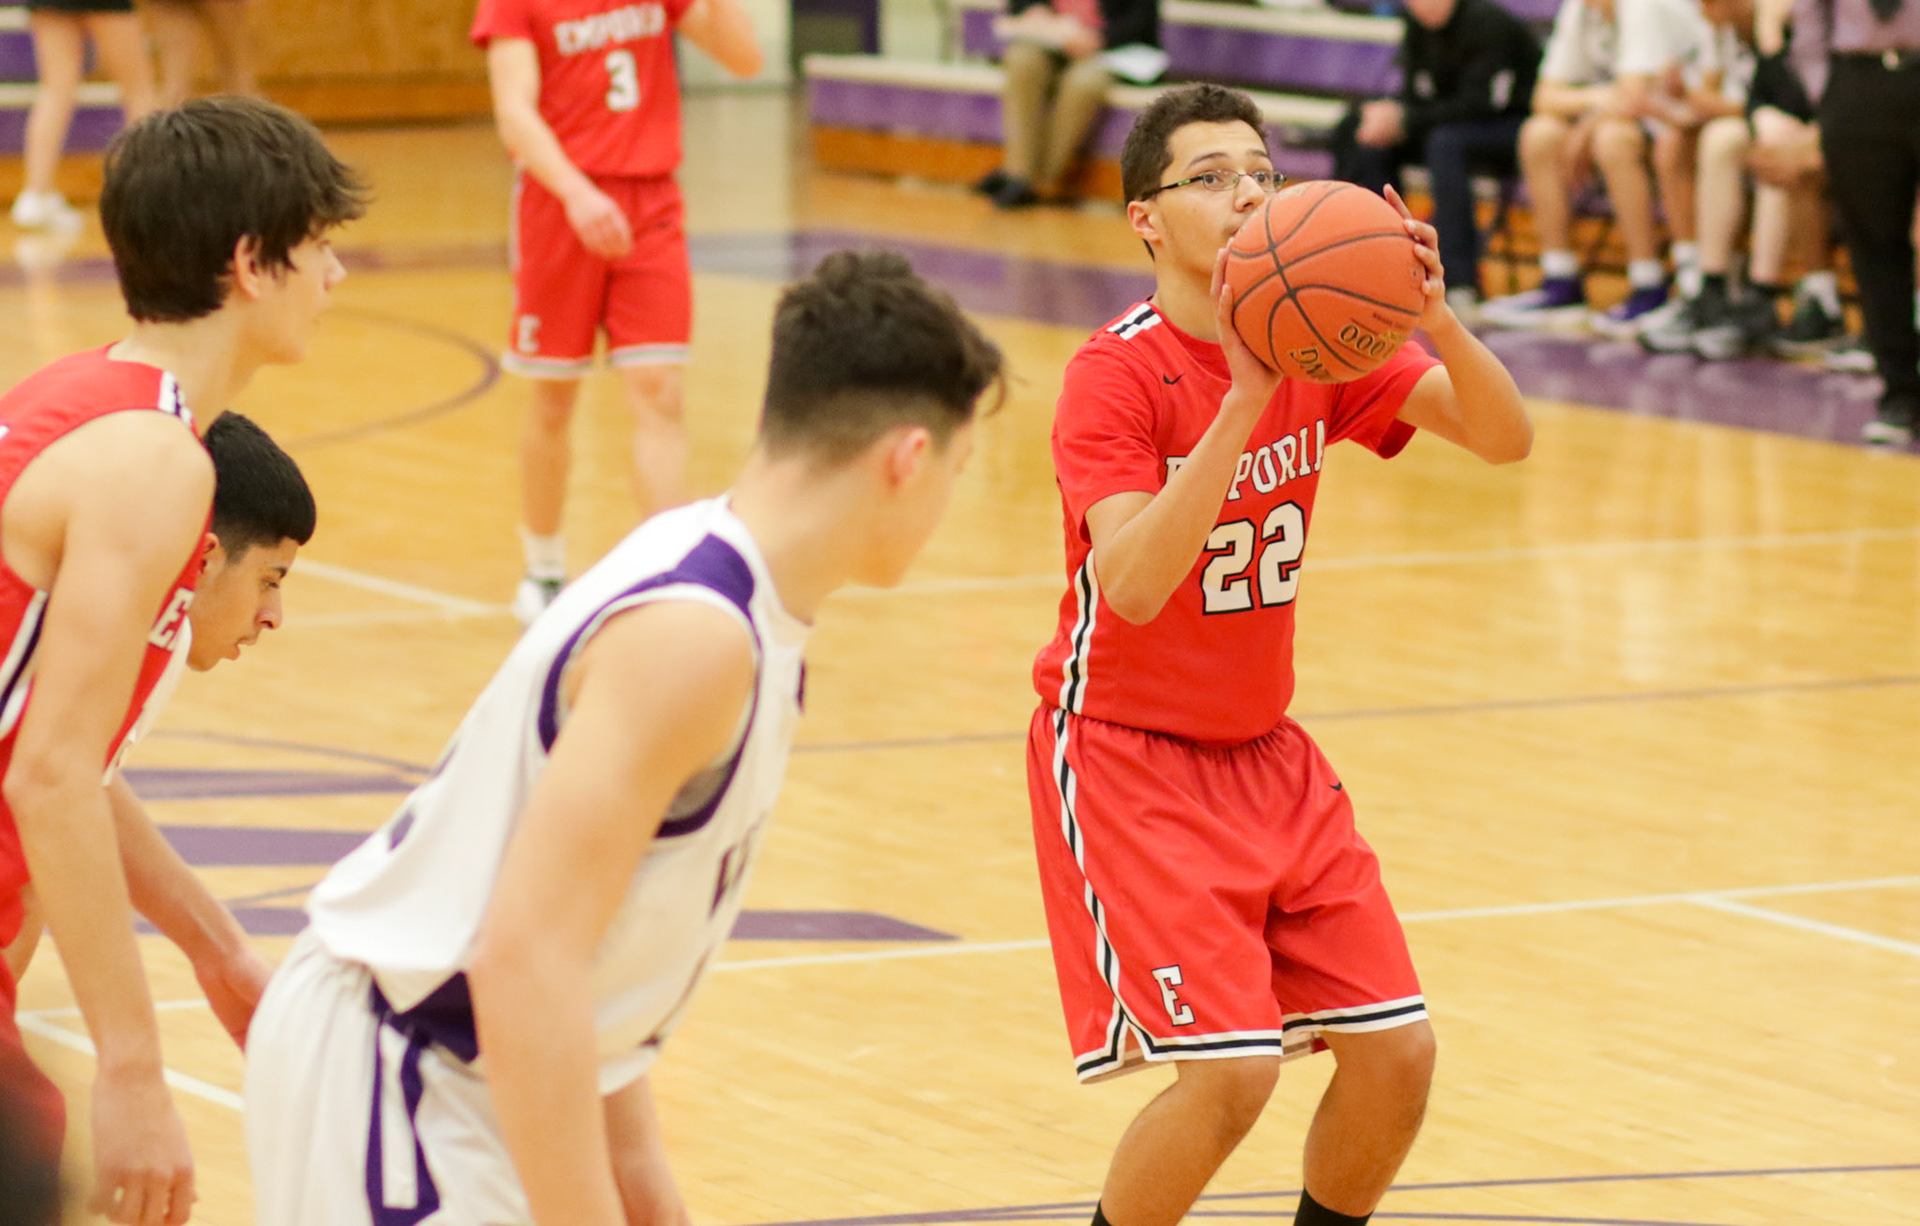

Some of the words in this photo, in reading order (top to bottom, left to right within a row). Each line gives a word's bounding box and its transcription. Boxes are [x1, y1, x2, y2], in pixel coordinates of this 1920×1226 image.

[605, 49, 641, 112] 3
[518, 315, 541, 352] E
[1165, 418, 1325, 501] PORI
[1200, 500, 1305, 615] 22
[1151, 964, 1196, 1027] E
